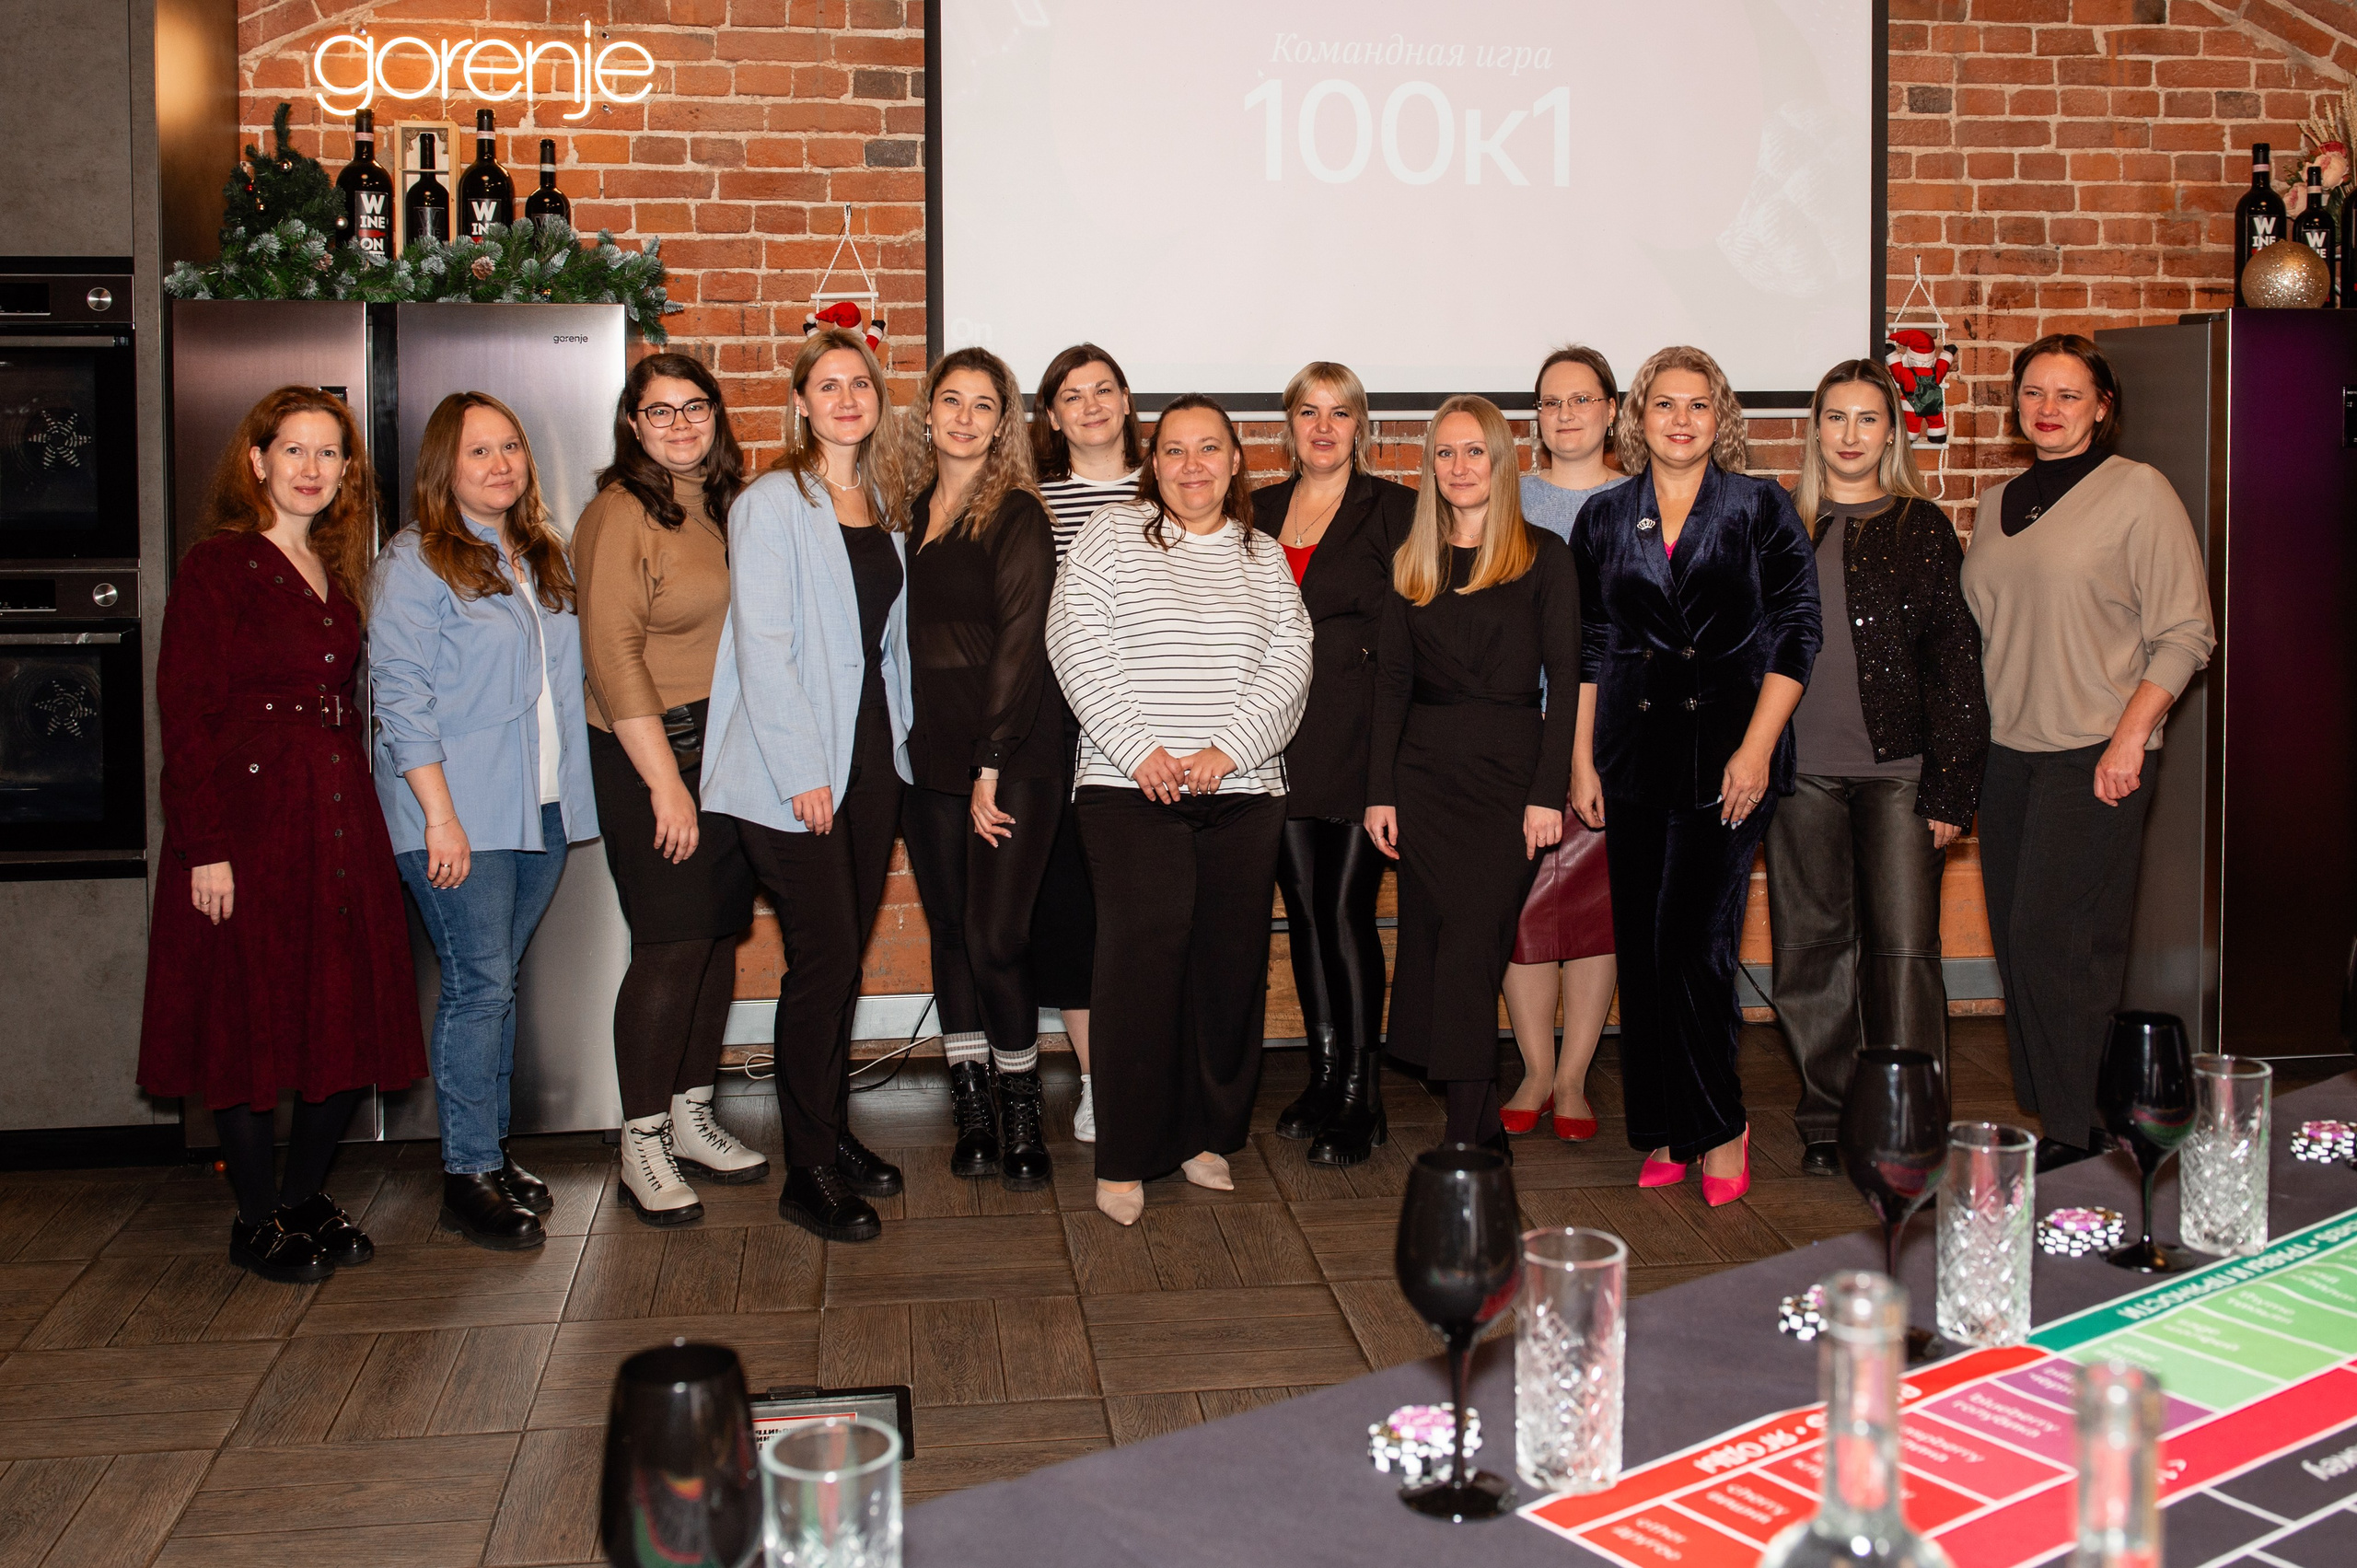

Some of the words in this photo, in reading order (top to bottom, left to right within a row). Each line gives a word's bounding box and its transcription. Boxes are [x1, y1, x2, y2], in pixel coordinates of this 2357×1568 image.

[1269, 32, 1466, 68] Командная
[1475, 44, 1553, 75] игра
[314, 19, 655, 120] gorenje
[1244, 78, 1570, 187] 100к1
[360, 193, 385, 215] W
[359, 215, 386, 229] INE
[471, 222, 495, 236] IN
[360, 238, 384, 251] ON
[552, 333, 588, 344] gorenje
